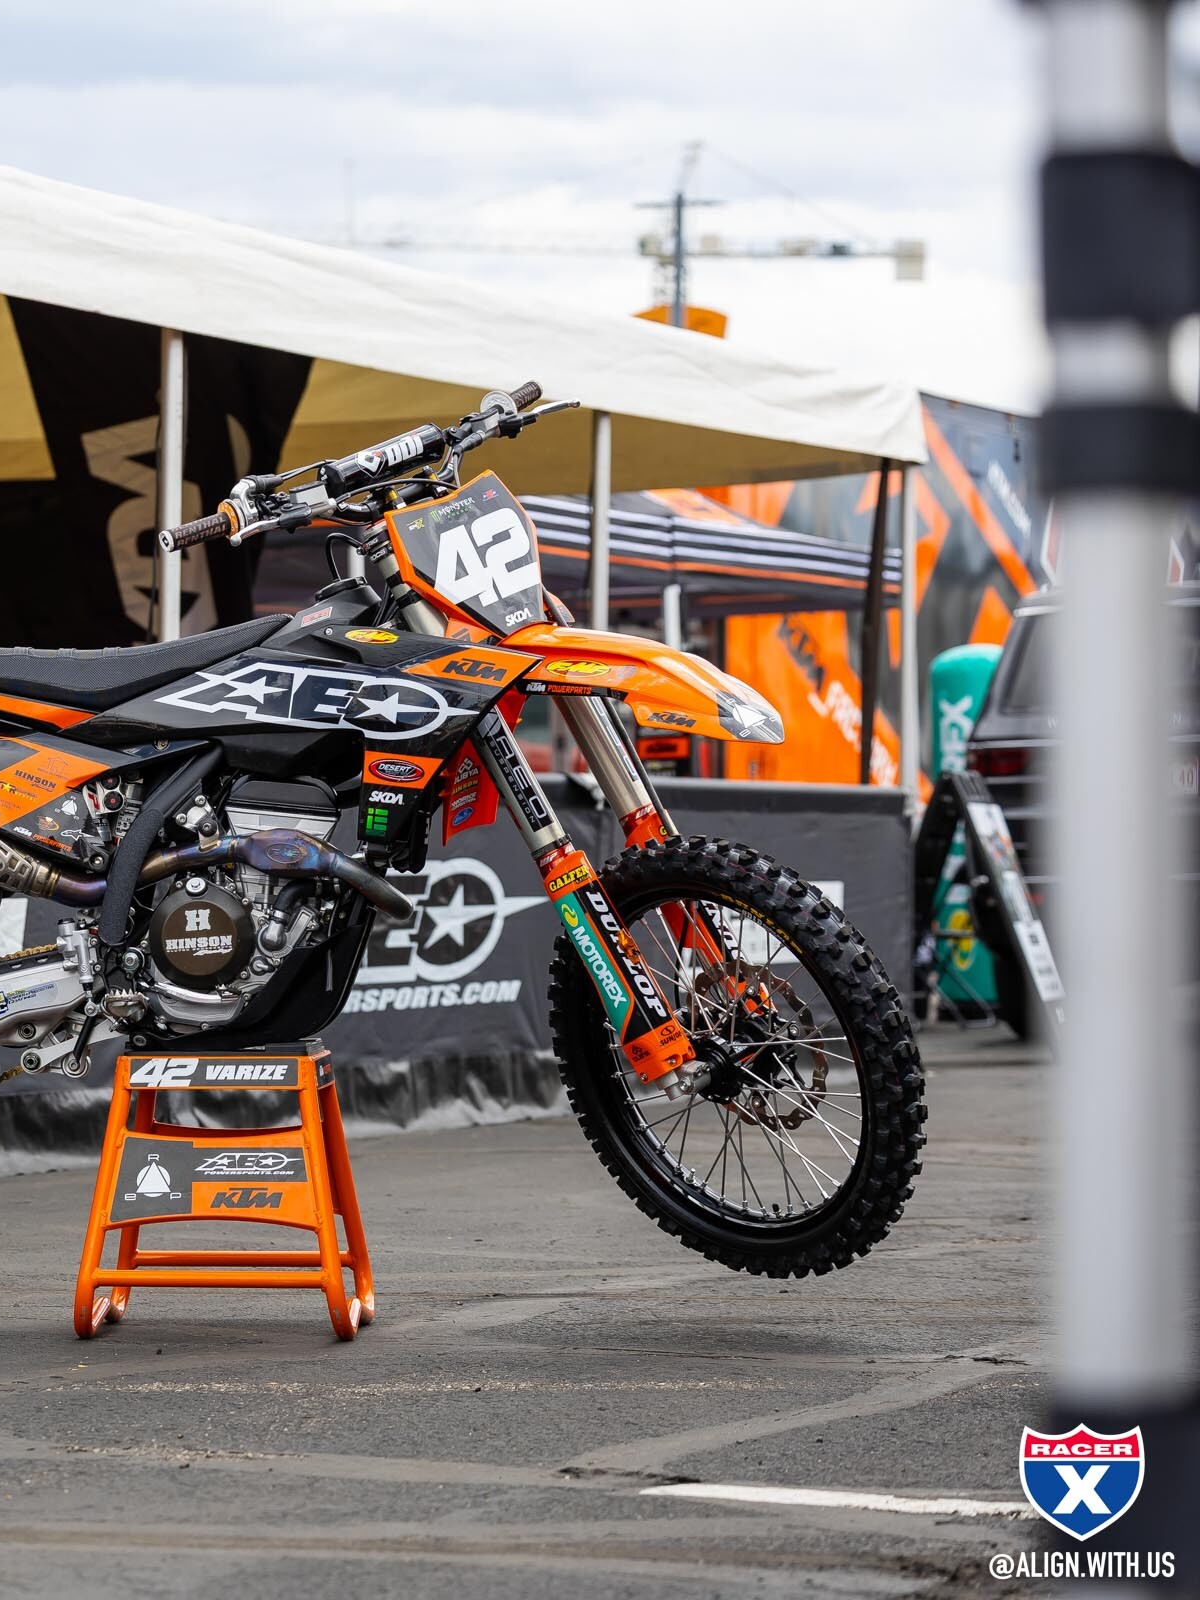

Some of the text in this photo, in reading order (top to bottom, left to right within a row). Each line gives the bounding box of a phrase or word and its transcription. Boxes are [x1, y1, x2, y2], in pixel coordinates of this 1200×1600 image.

[434, 507, 537, 607] 42
[505, 607, 532, 627] SKDA
[442, 657, 507, 682] KTM
[525, 682, 592, 695] KTM POWERPARTS
[152, 662, 480, 740] AEO
[648, 711, 697, 728] KTM
[14, 769, 57, 789] HINSON
[378, 763, 413, 774] DESERT
[496, 735, 548, 819] AEO
[369, 790, 404, 806] SKDA
[549, 865, 589, 892] GALFER
[185, 908, 211, 931] H
[165, 934, 233, 950] HINSON
[572, 925, 628, 1008] MOTOREX
[129, 1058, 289, 1088] 42 VARIZE
[195, 1152, 304, 1171] AEO
[210, 1187, 283, 1209] KTM
